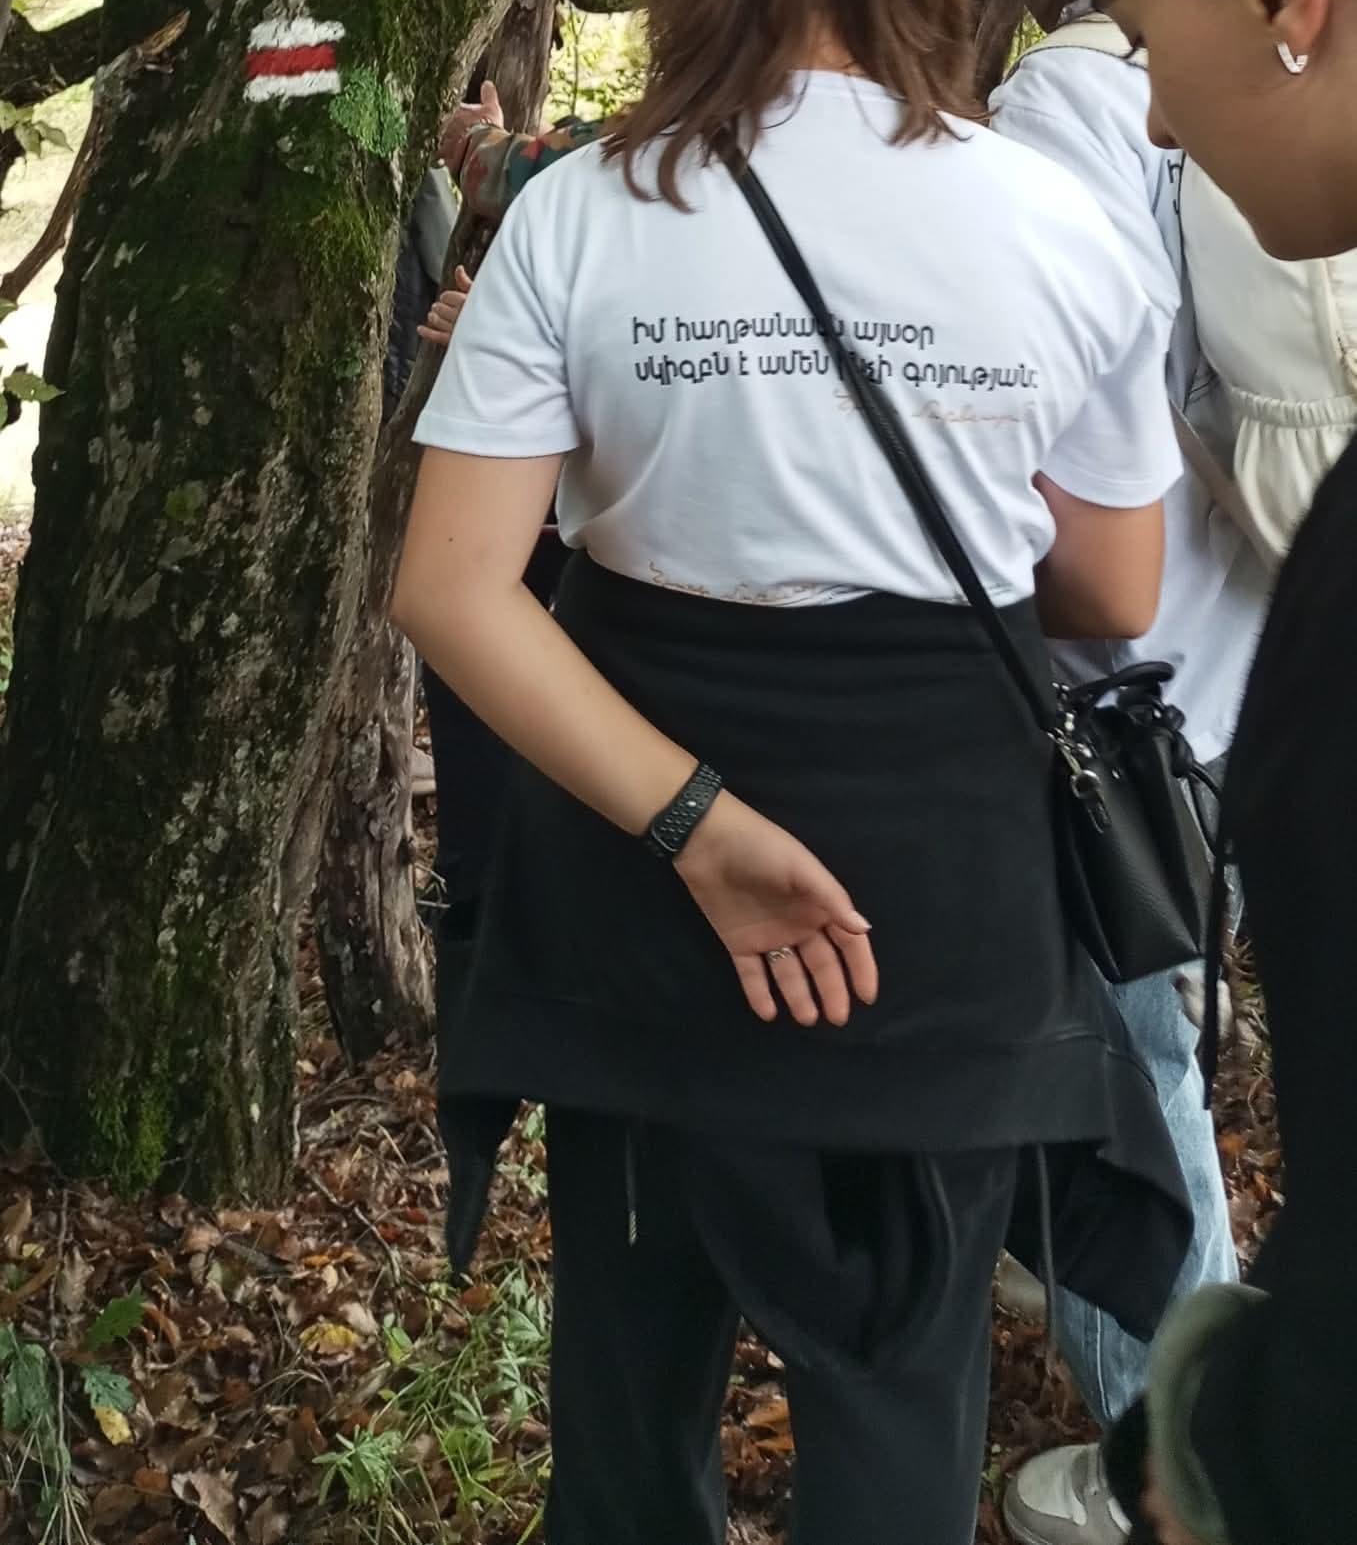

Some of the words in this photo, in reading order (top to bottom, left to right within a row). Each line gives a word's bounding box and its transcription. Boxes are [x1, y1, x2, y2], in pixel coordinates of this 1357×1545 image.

[632, 316, 665, 344] Իմ
[675, 312, 844, 344] հաղթանան
[854, 321, 934, 350] այսօր
[635, 351, 729, 385] սկիզբն
[739, 350, 749, 376] է
[759, 349, 829, 375] ամեն
